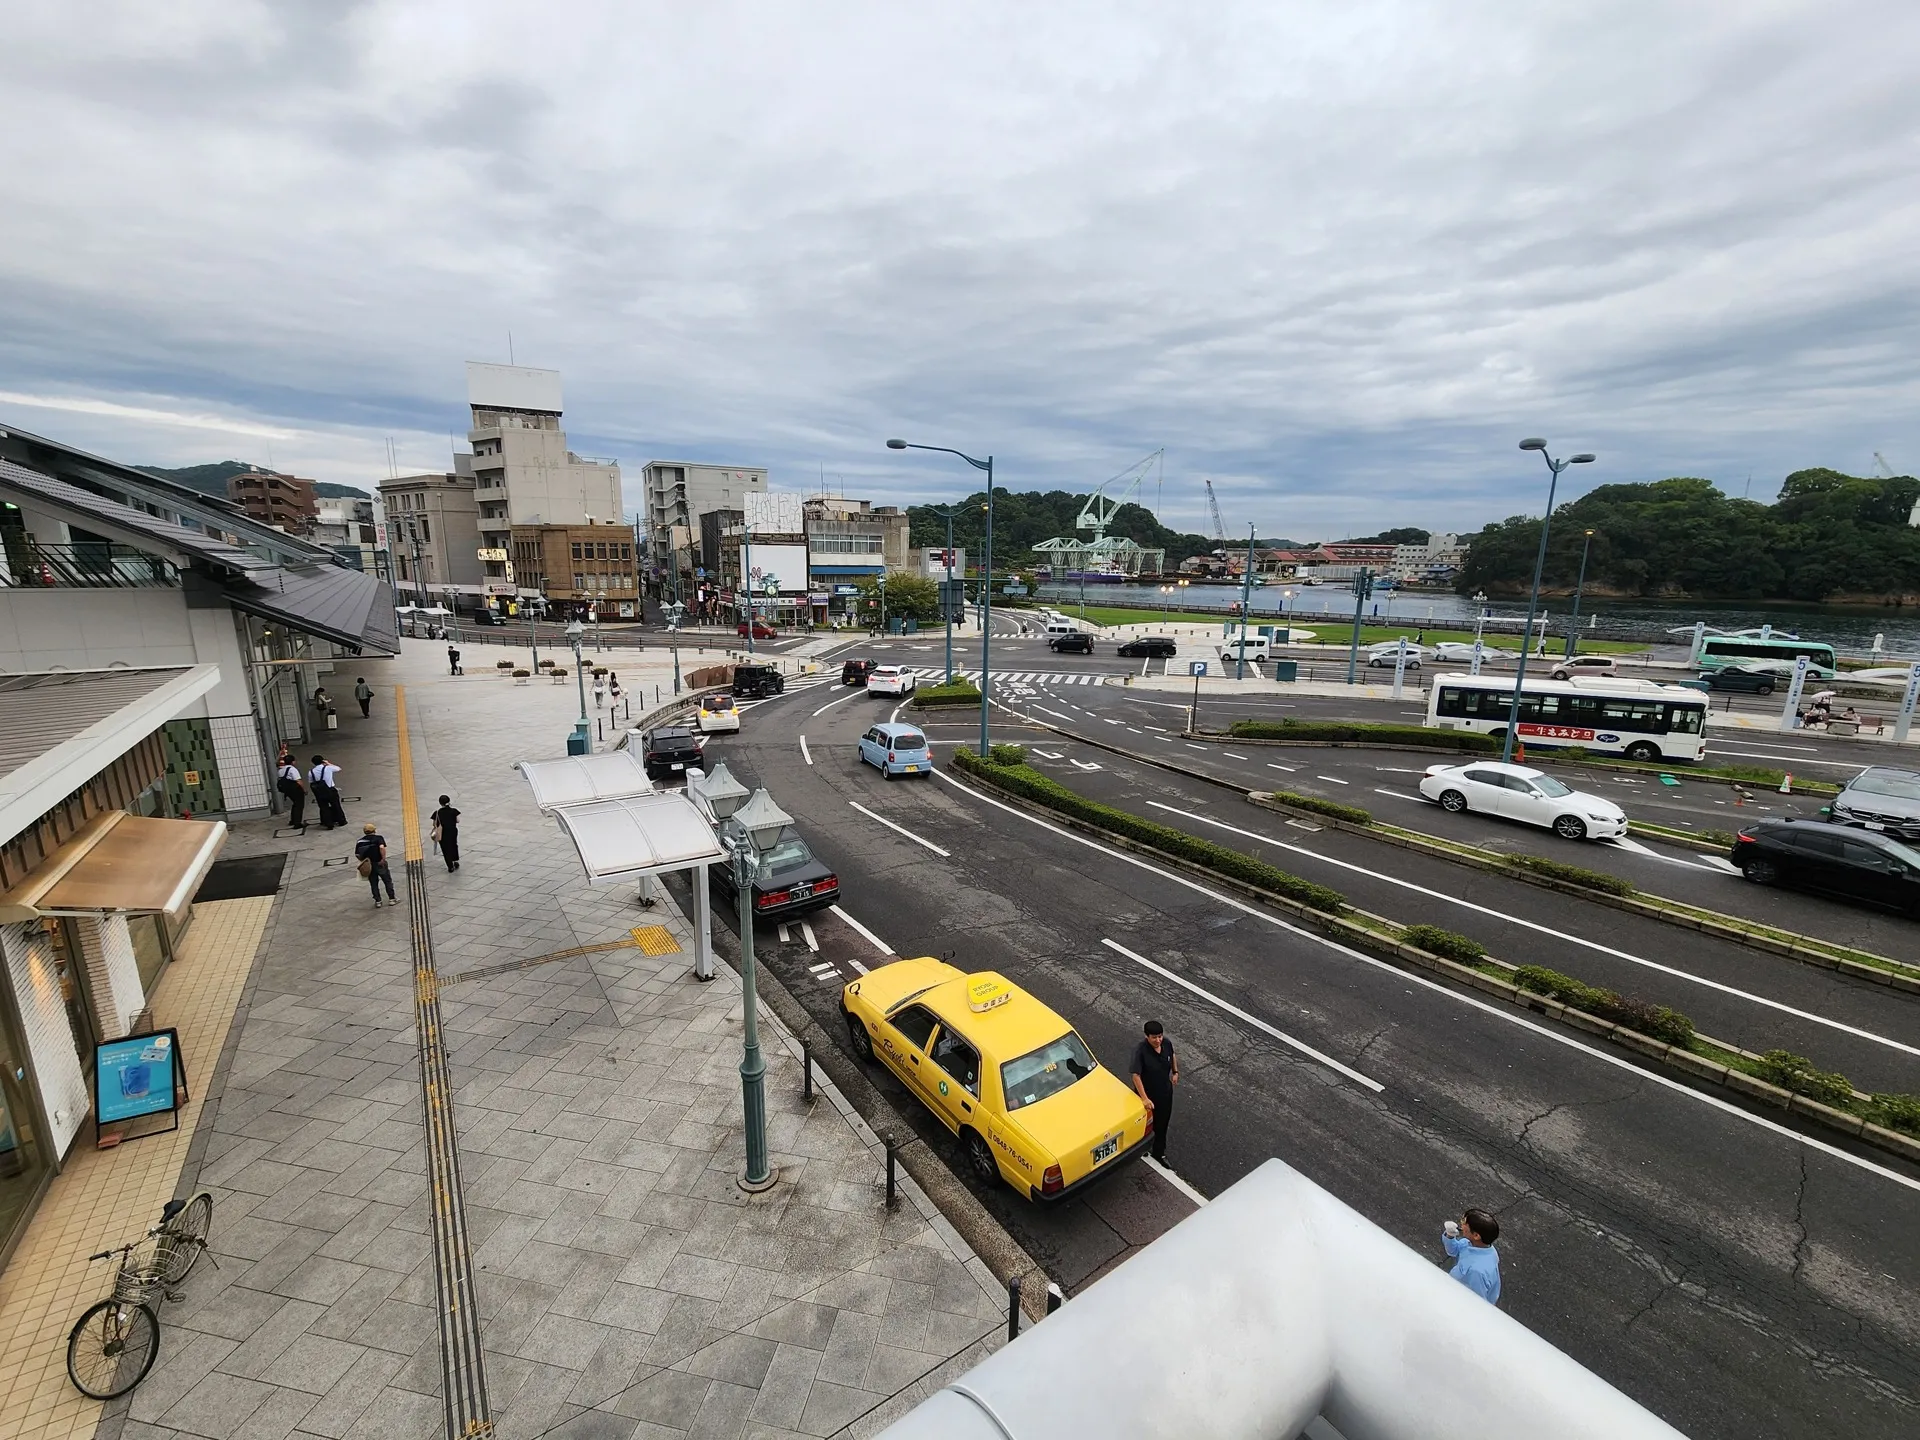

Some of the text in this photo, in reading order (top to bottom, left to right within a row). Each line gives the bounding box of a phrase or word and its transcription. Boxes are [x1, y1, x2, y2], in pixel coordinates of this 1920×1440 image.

[1400, 638, 1407, 649] 6
[1475, 642, 1482, 652] 6
[1194, 663, 1205, 675] P
[1797, 659, 1806, 671] 5
[972, 982, 993, 992] RYOBI
[976, 985, 999, 997] GROUP
[992, 1134, 1033, 1173] 0848-76-0541
